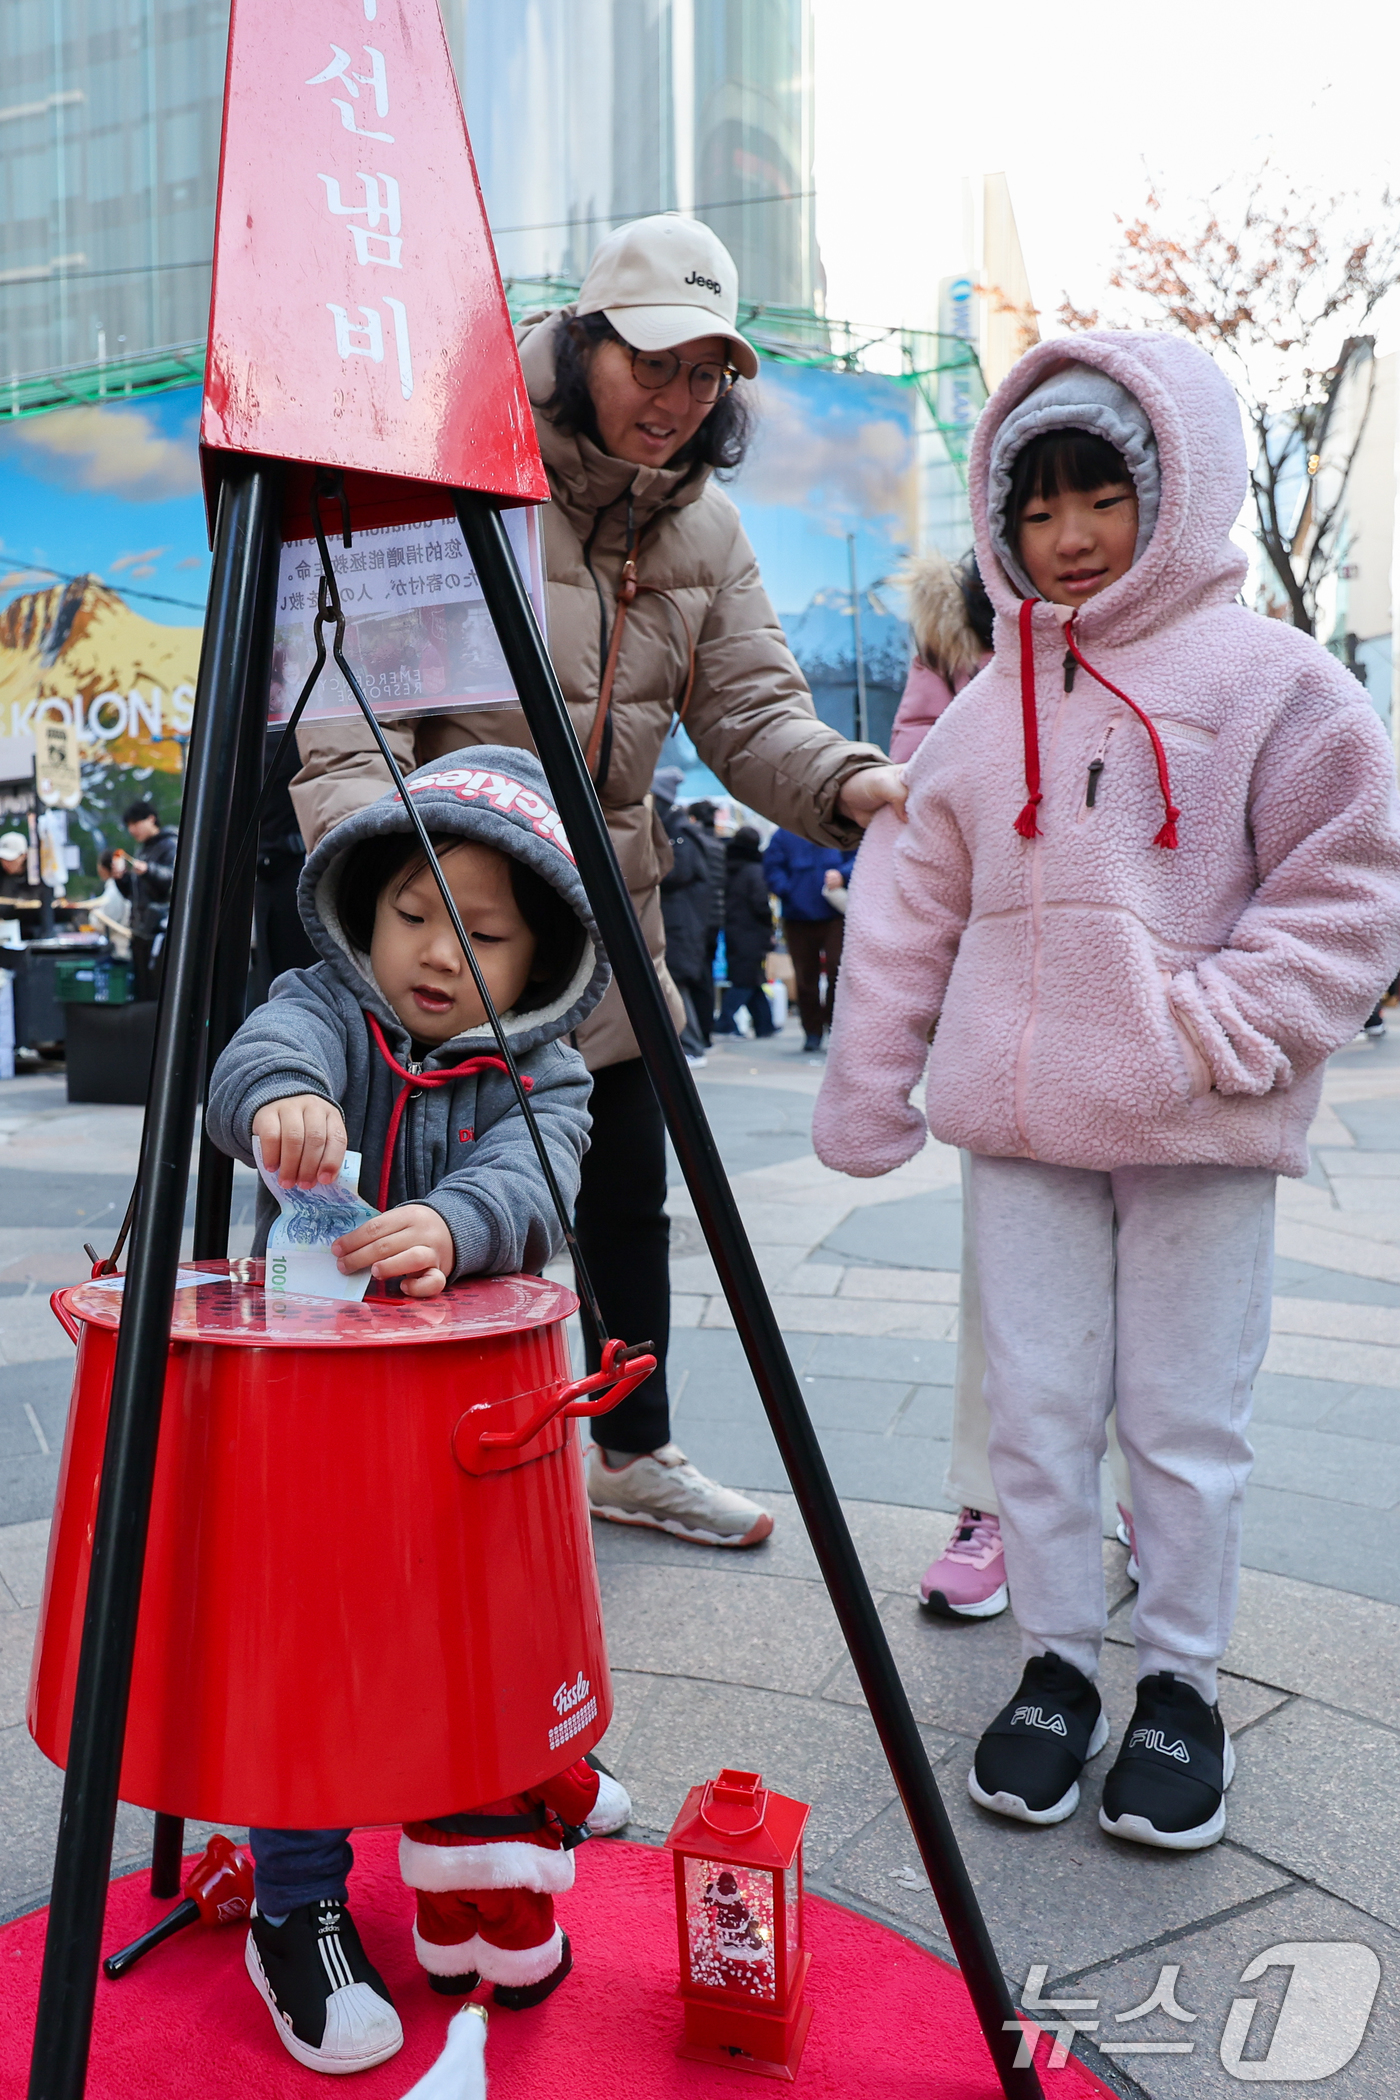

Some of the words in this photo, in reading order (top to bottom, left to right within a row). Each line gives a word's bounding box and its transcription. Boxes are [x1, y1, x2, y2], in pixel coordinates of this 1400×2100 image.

[304, 0, 414, 401] 선냄비
[684, 271, 722, 295] Jeep
[11, 686, 163, 742] KOLON
[552, 1671, 590, 1716] Fissler
[1010, 1706, 1068, 1737] FILA
[1128, 1729, 1190, 1764] FILA
[318, 1925, 341, 1934] adidas
